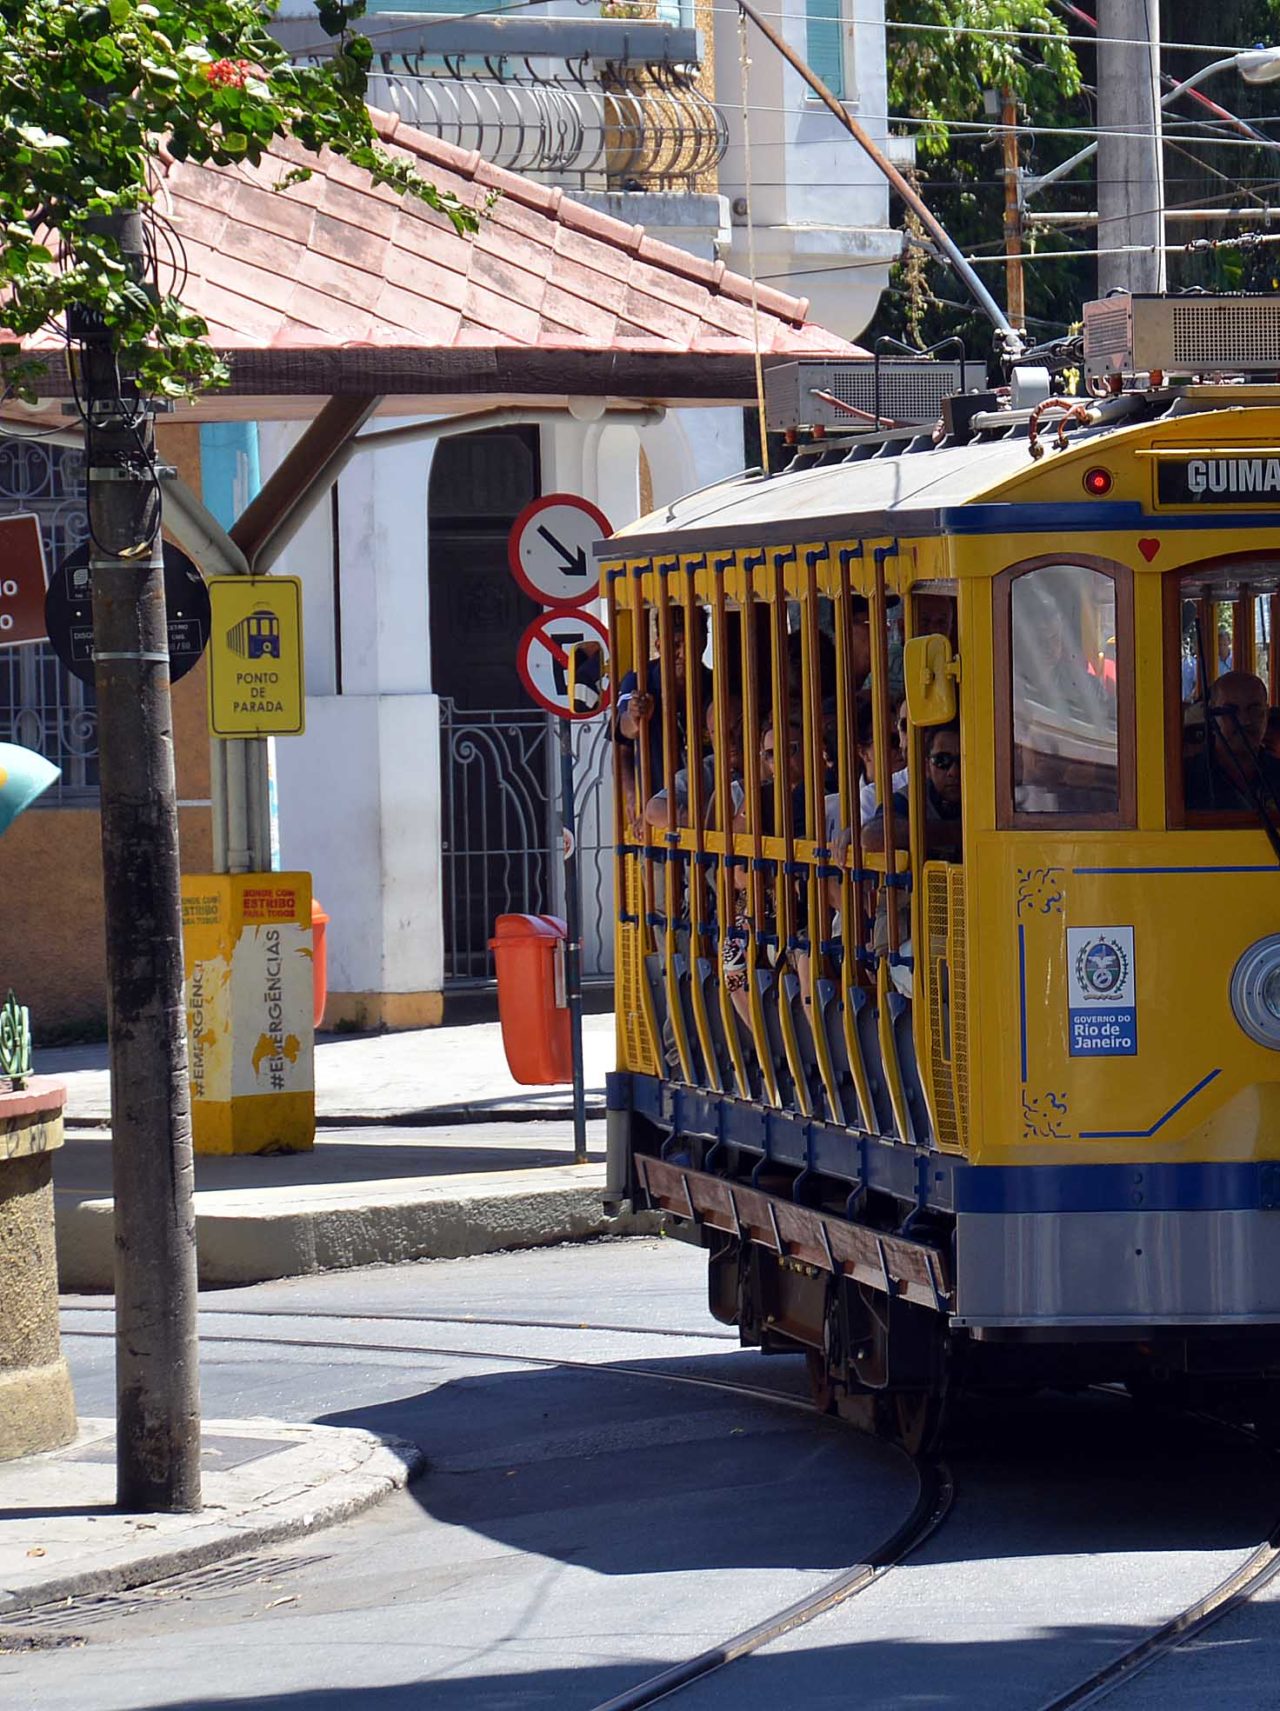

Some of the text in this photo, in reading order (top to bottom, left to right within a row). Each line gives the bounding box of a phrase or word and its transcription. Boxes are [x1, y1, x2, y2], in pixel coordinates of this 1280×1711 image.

[236, 673, 279, 685] PONTO
[250, 687, 266, 699] DE
[233, 701, 284, 713] PARADA
[243, 897, 296, 909] ESTRIBO
[1074, 1014, 1131, 1024] GOVERNO DO
[1074, 1023, 1120, 1036] Rio de
[1074, 1036, 1132, 1049] Janeiro
